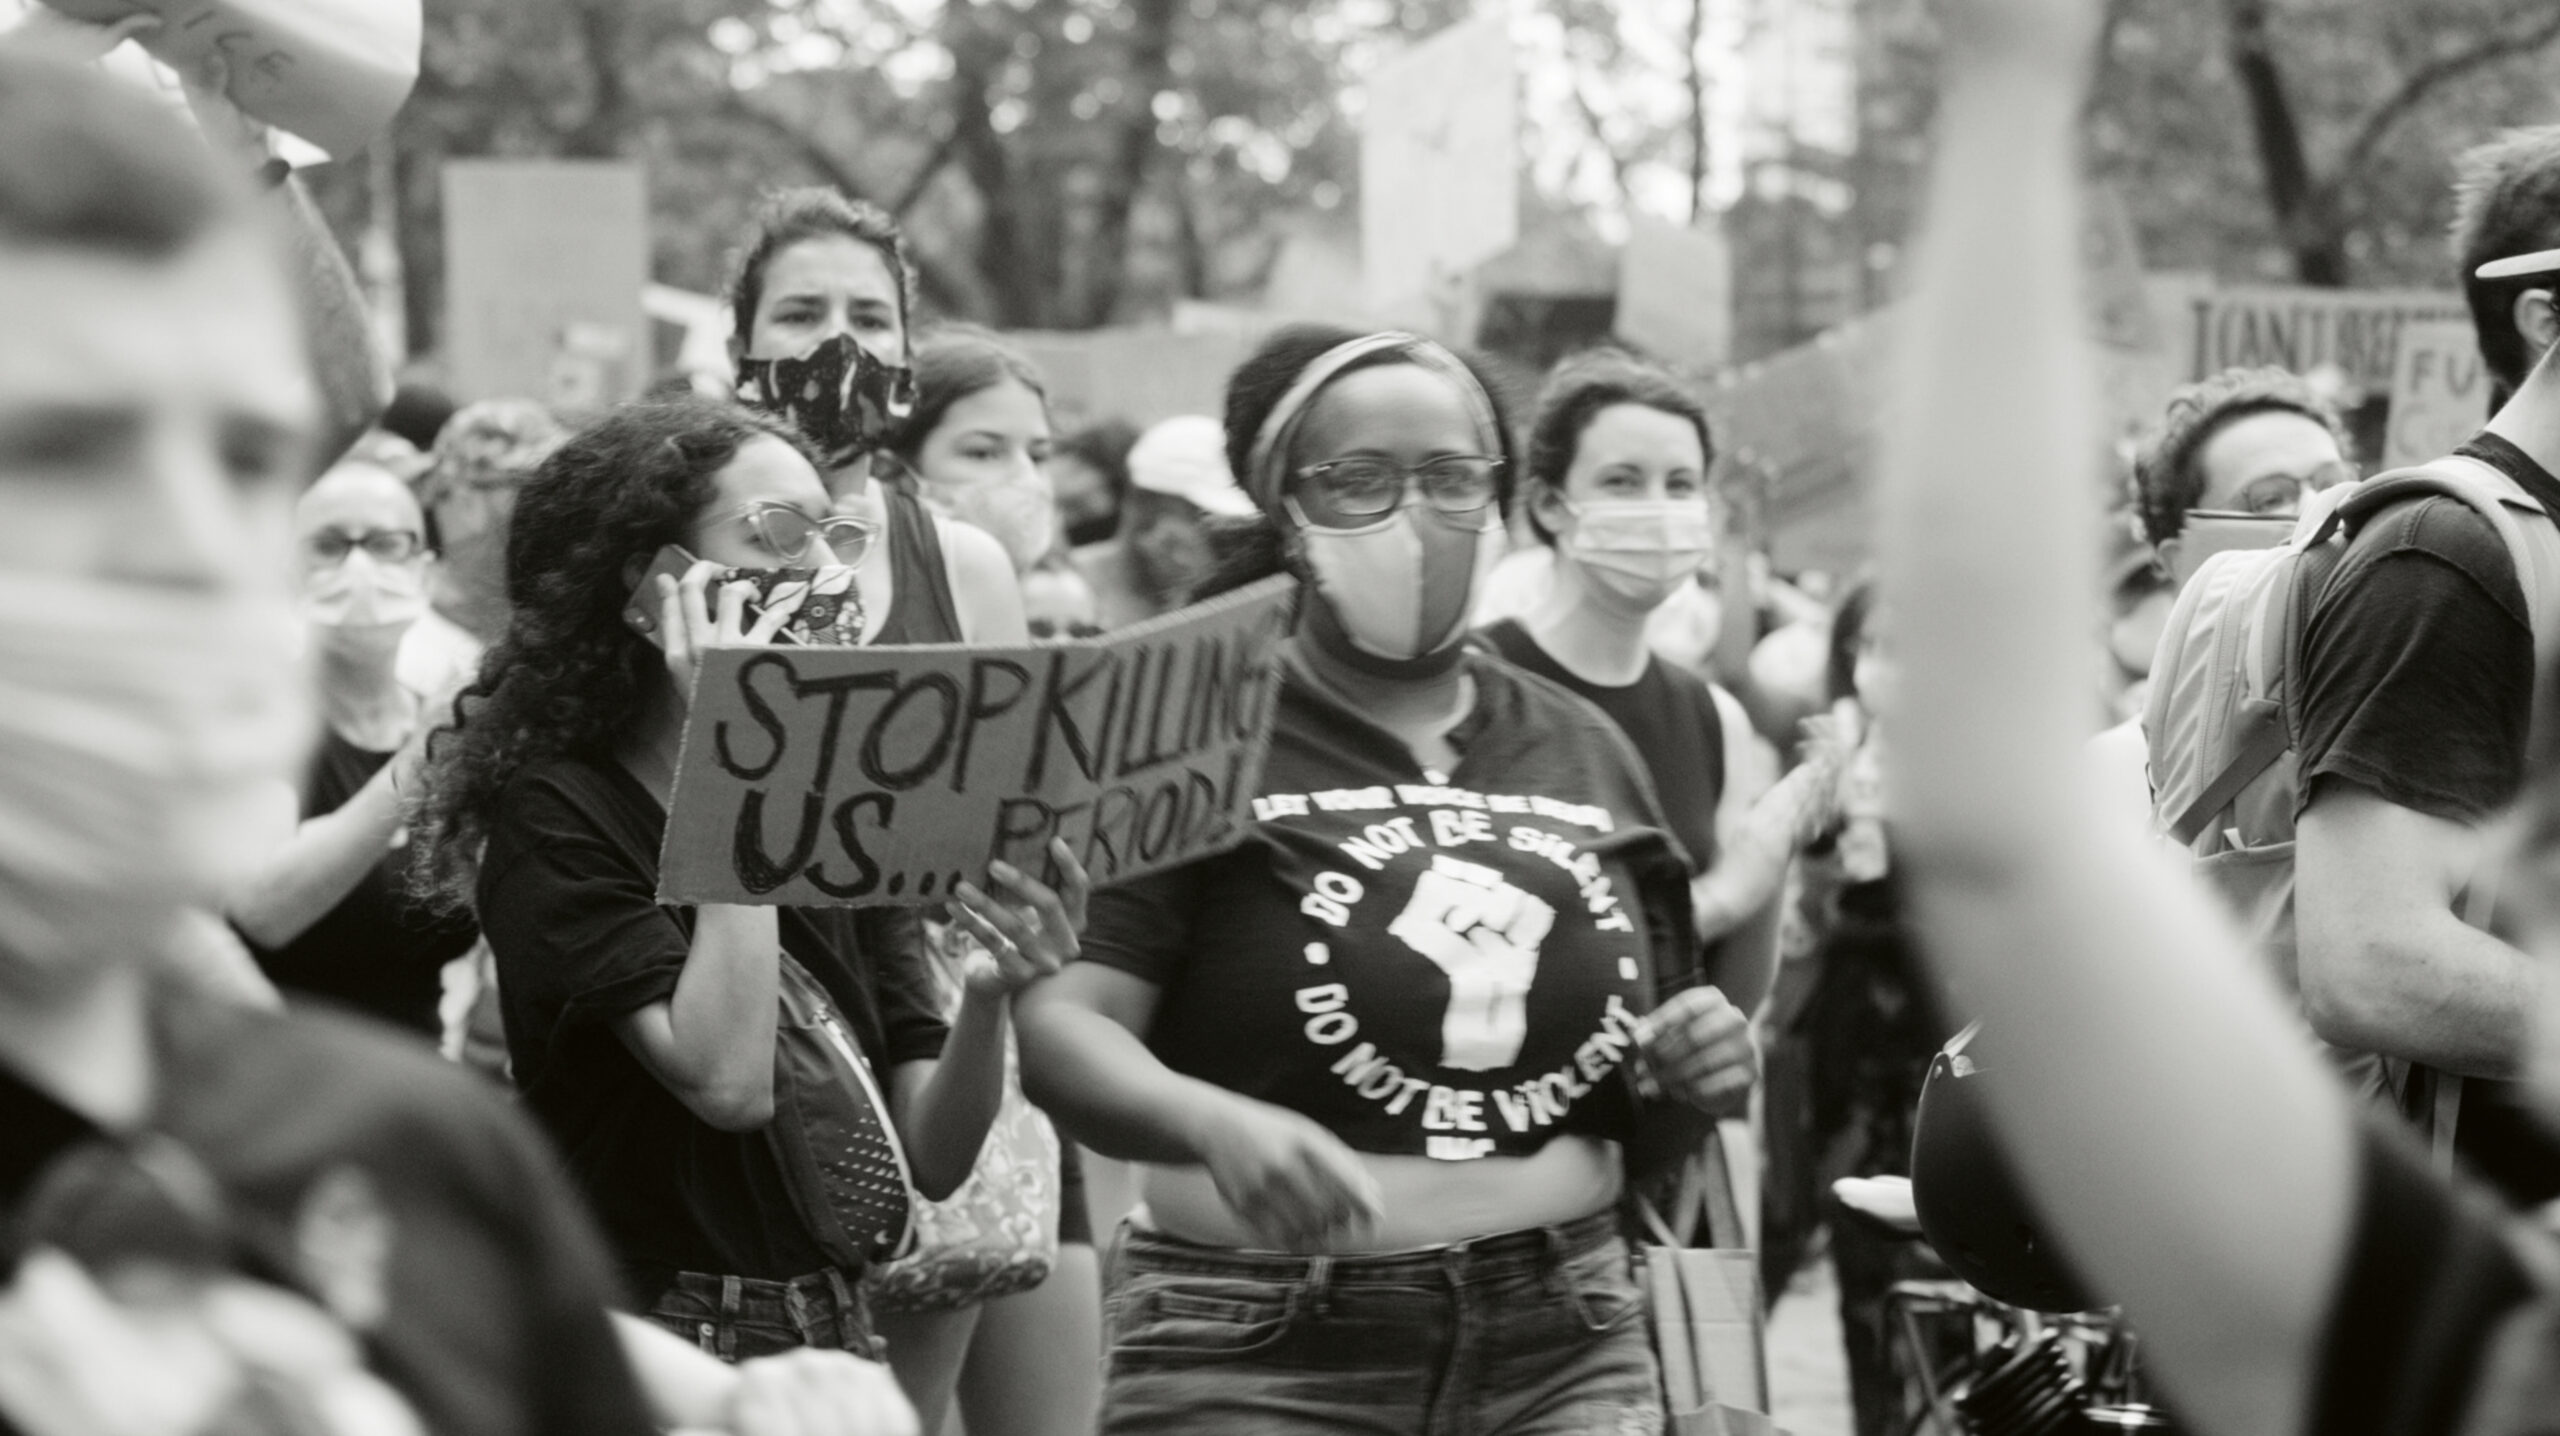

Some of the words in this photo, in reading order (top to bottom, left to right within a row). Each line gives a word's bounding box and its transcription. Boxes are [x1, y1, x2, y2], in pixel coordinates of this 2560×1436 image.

[714, 651, 1032, 793] STOP
[1022, 607, 1284, 793] KILLING
[984, 750, 1241, 895] PERIOD!
[1301, 871, 1364, 927] DO
[1338, 816, 1426, 870] NOT
[1428, 809, 1498, 848] BE
[1507, 826, 1634, 932] SILENT
[1295, 983, 1358, 1044] DO
[1329, 1042, 1431, 1115] NOT
[1421, 1085, 1488, 1131] BE
[1492, 994, 1643, 1132] VIOLENT
